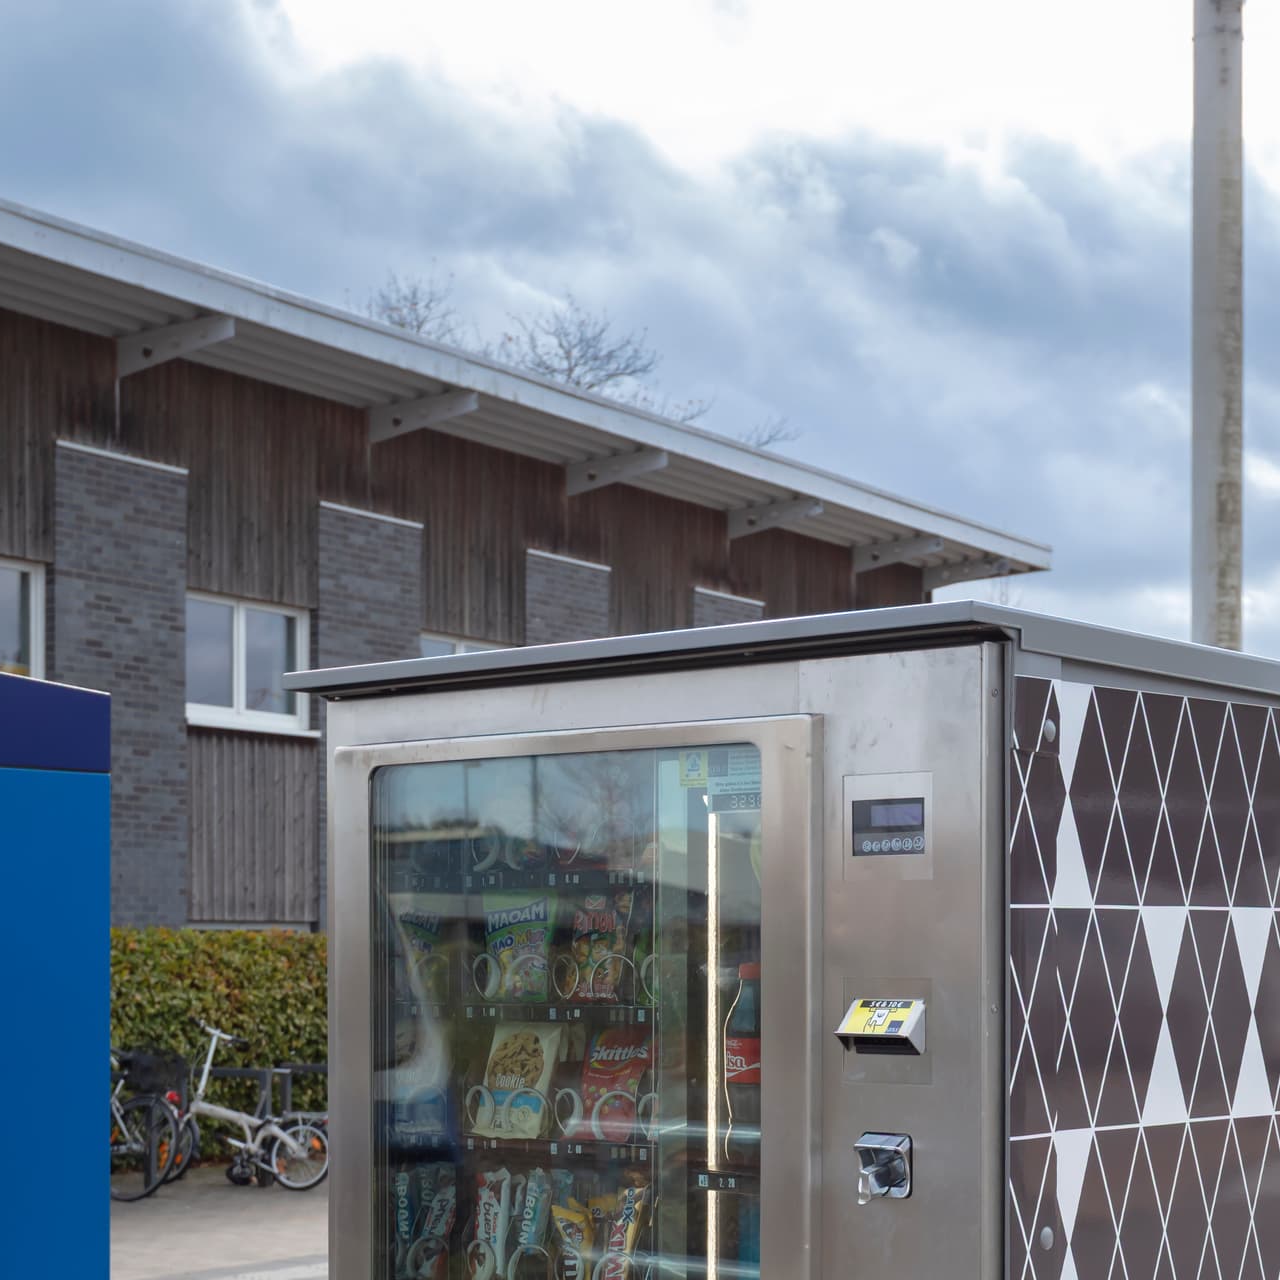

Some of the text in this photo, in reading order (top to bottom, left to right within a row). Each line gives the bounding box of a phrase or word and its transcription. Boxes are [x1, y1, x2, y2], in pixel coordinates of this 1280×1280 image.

[487, 902, 545, 933] MAOAM
[590, 1045, 648, 1062] Skittles
[519, 1195, 536, 1246] BOUN
